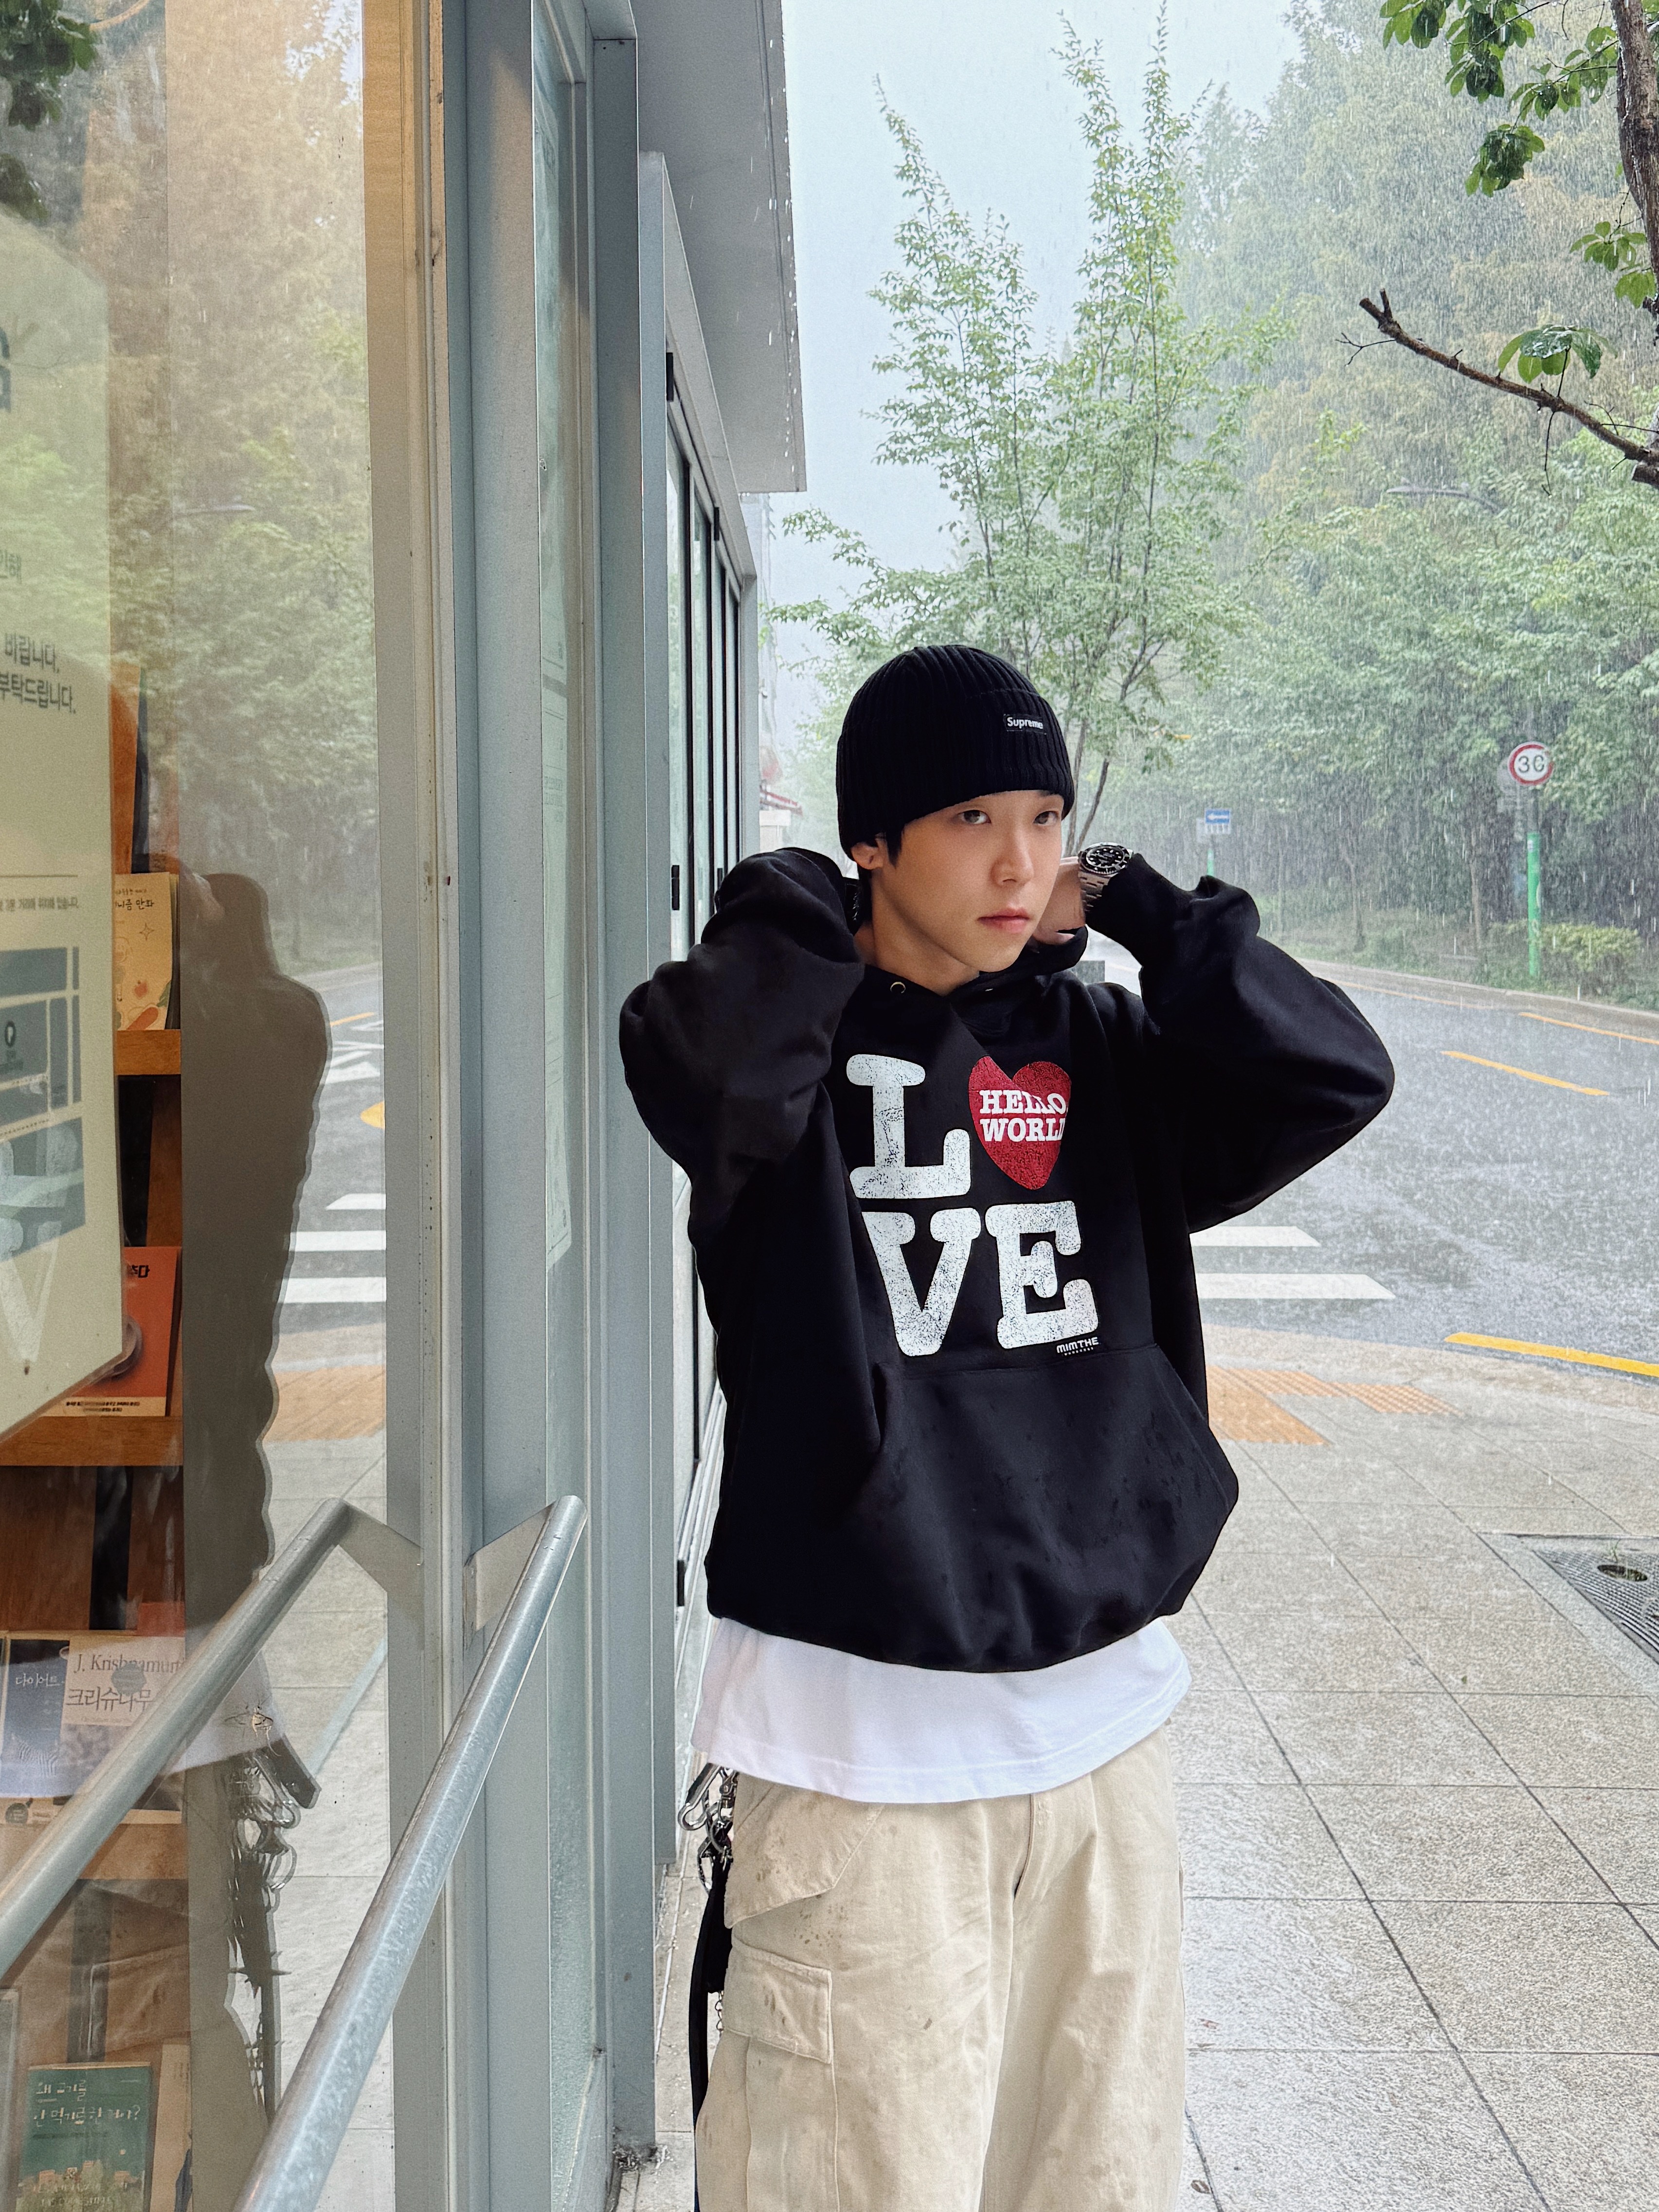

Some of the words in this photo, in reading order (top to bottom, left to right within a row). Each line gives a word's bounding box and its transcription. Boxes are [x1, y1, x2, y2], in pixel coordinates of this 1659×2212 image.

[1007, 717, 1044, 729] Supreme
[1518, 755, 1545, 773] 30
[846, 1053, 971, 1199] L
[861, 1200, 1099, 1357] VE
[73, 1654, 86, 1673] J.
